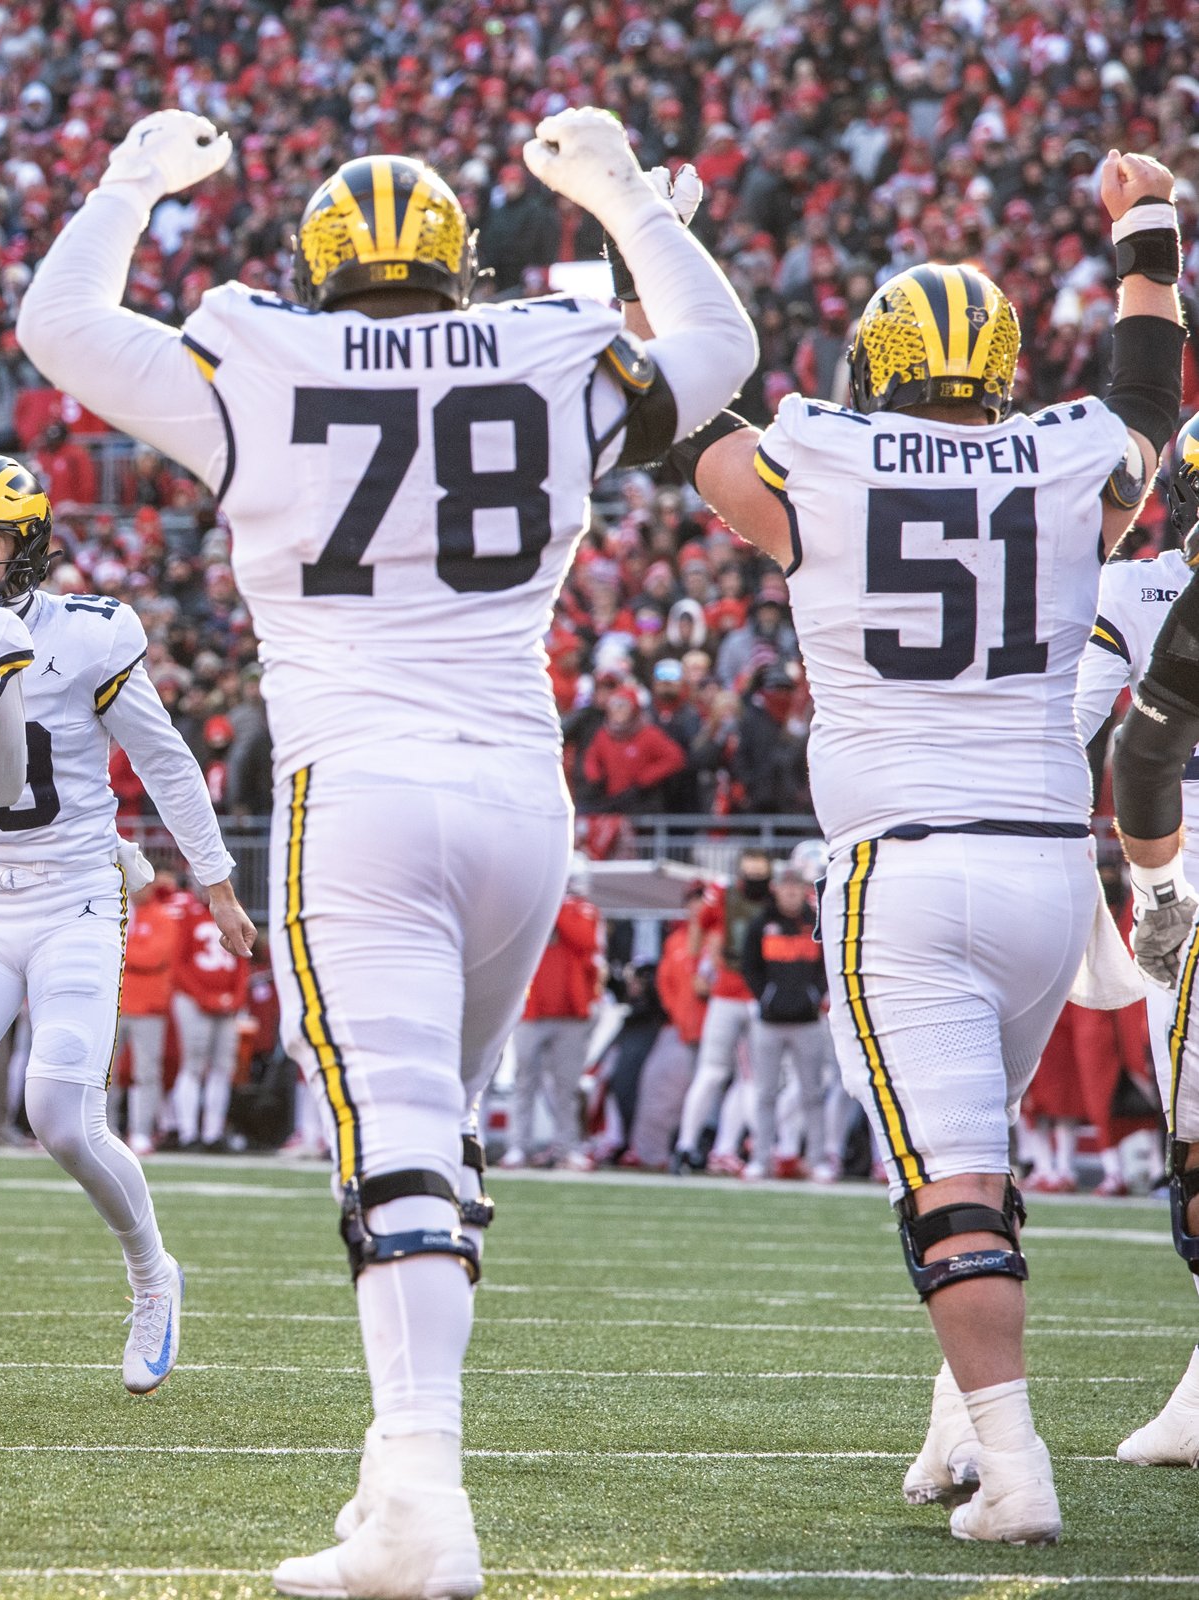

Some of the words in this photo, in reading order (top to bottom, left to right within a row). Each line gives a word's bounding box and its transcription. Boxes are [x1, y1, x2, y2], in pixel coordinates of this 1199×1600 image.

[344, 321, 500, 371] HINTON
[913, 366, 925, 380] 51
[873, 431, 1040, 475] CRIPPEN
[290, 382, 552, 597] 78
[862, 485, 1049, 682] 51
[949, 1256, 1002, 1271] DONJOY
